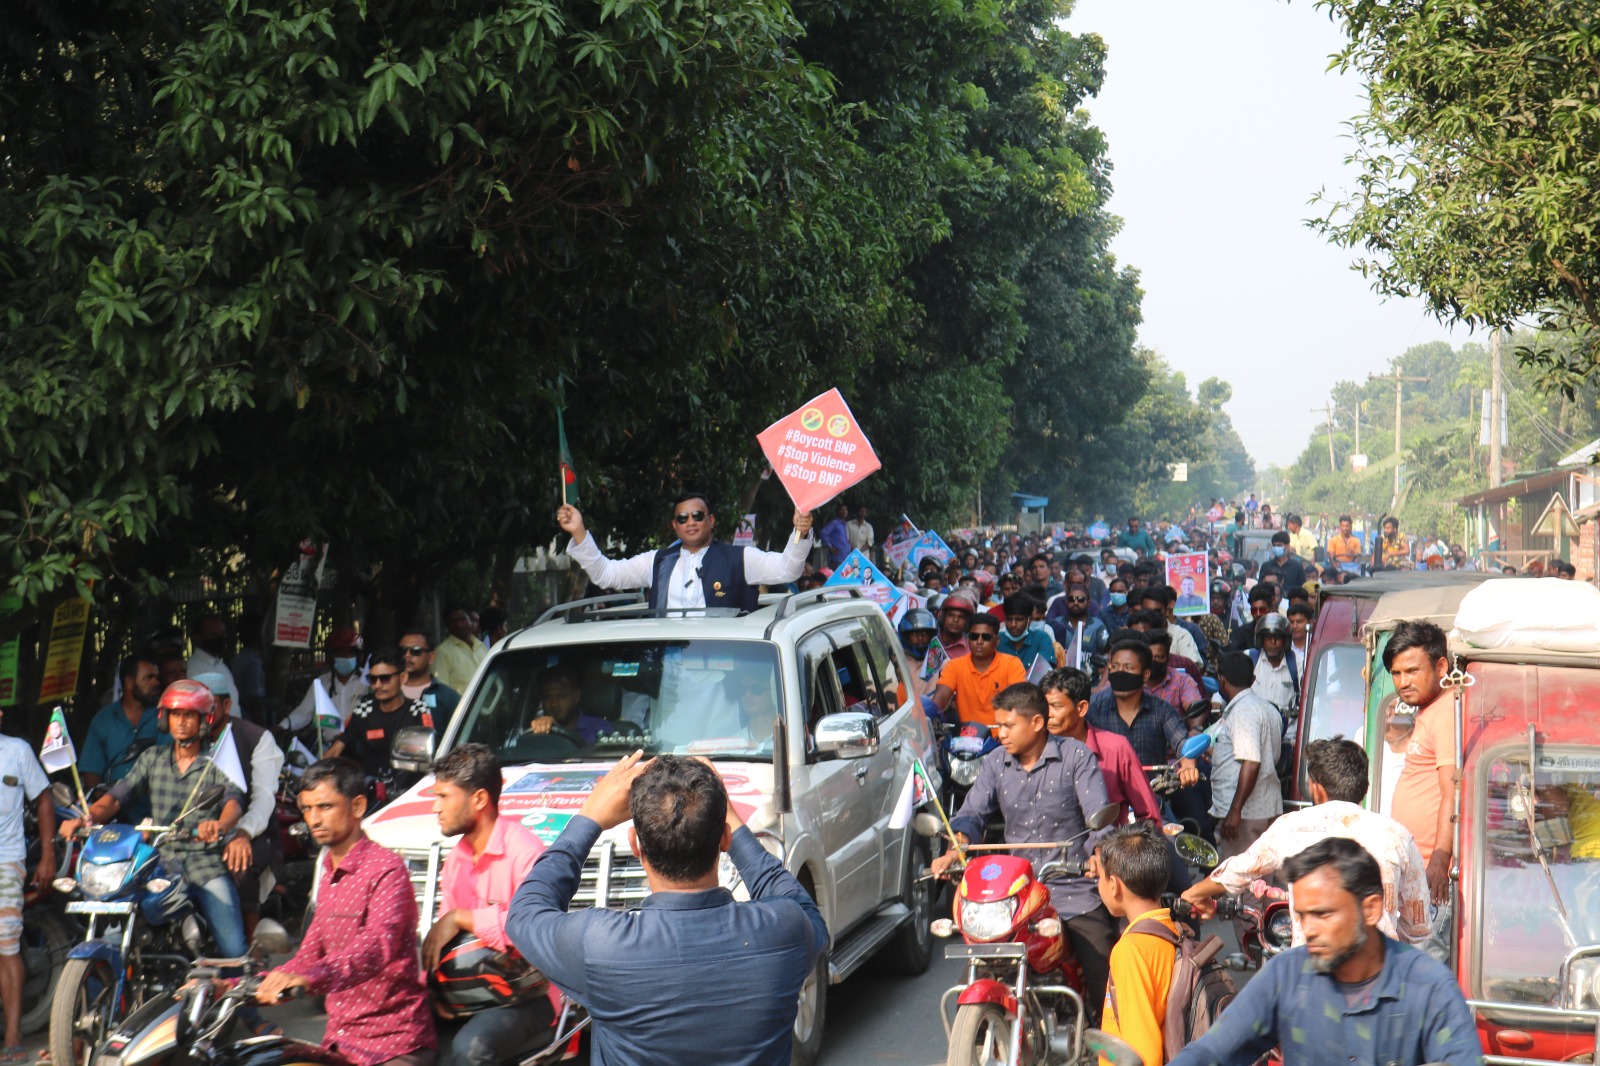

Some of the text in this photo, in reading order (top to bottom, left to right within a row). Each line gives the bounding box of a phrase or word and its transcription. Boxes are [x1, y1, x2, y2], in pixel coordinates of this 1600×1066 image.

[786, 429, 856, 455] #Boycott BNP
[777, 444, 855, 473] #Stop Violence
[784, 463, 842, 487] #Stop BNP
